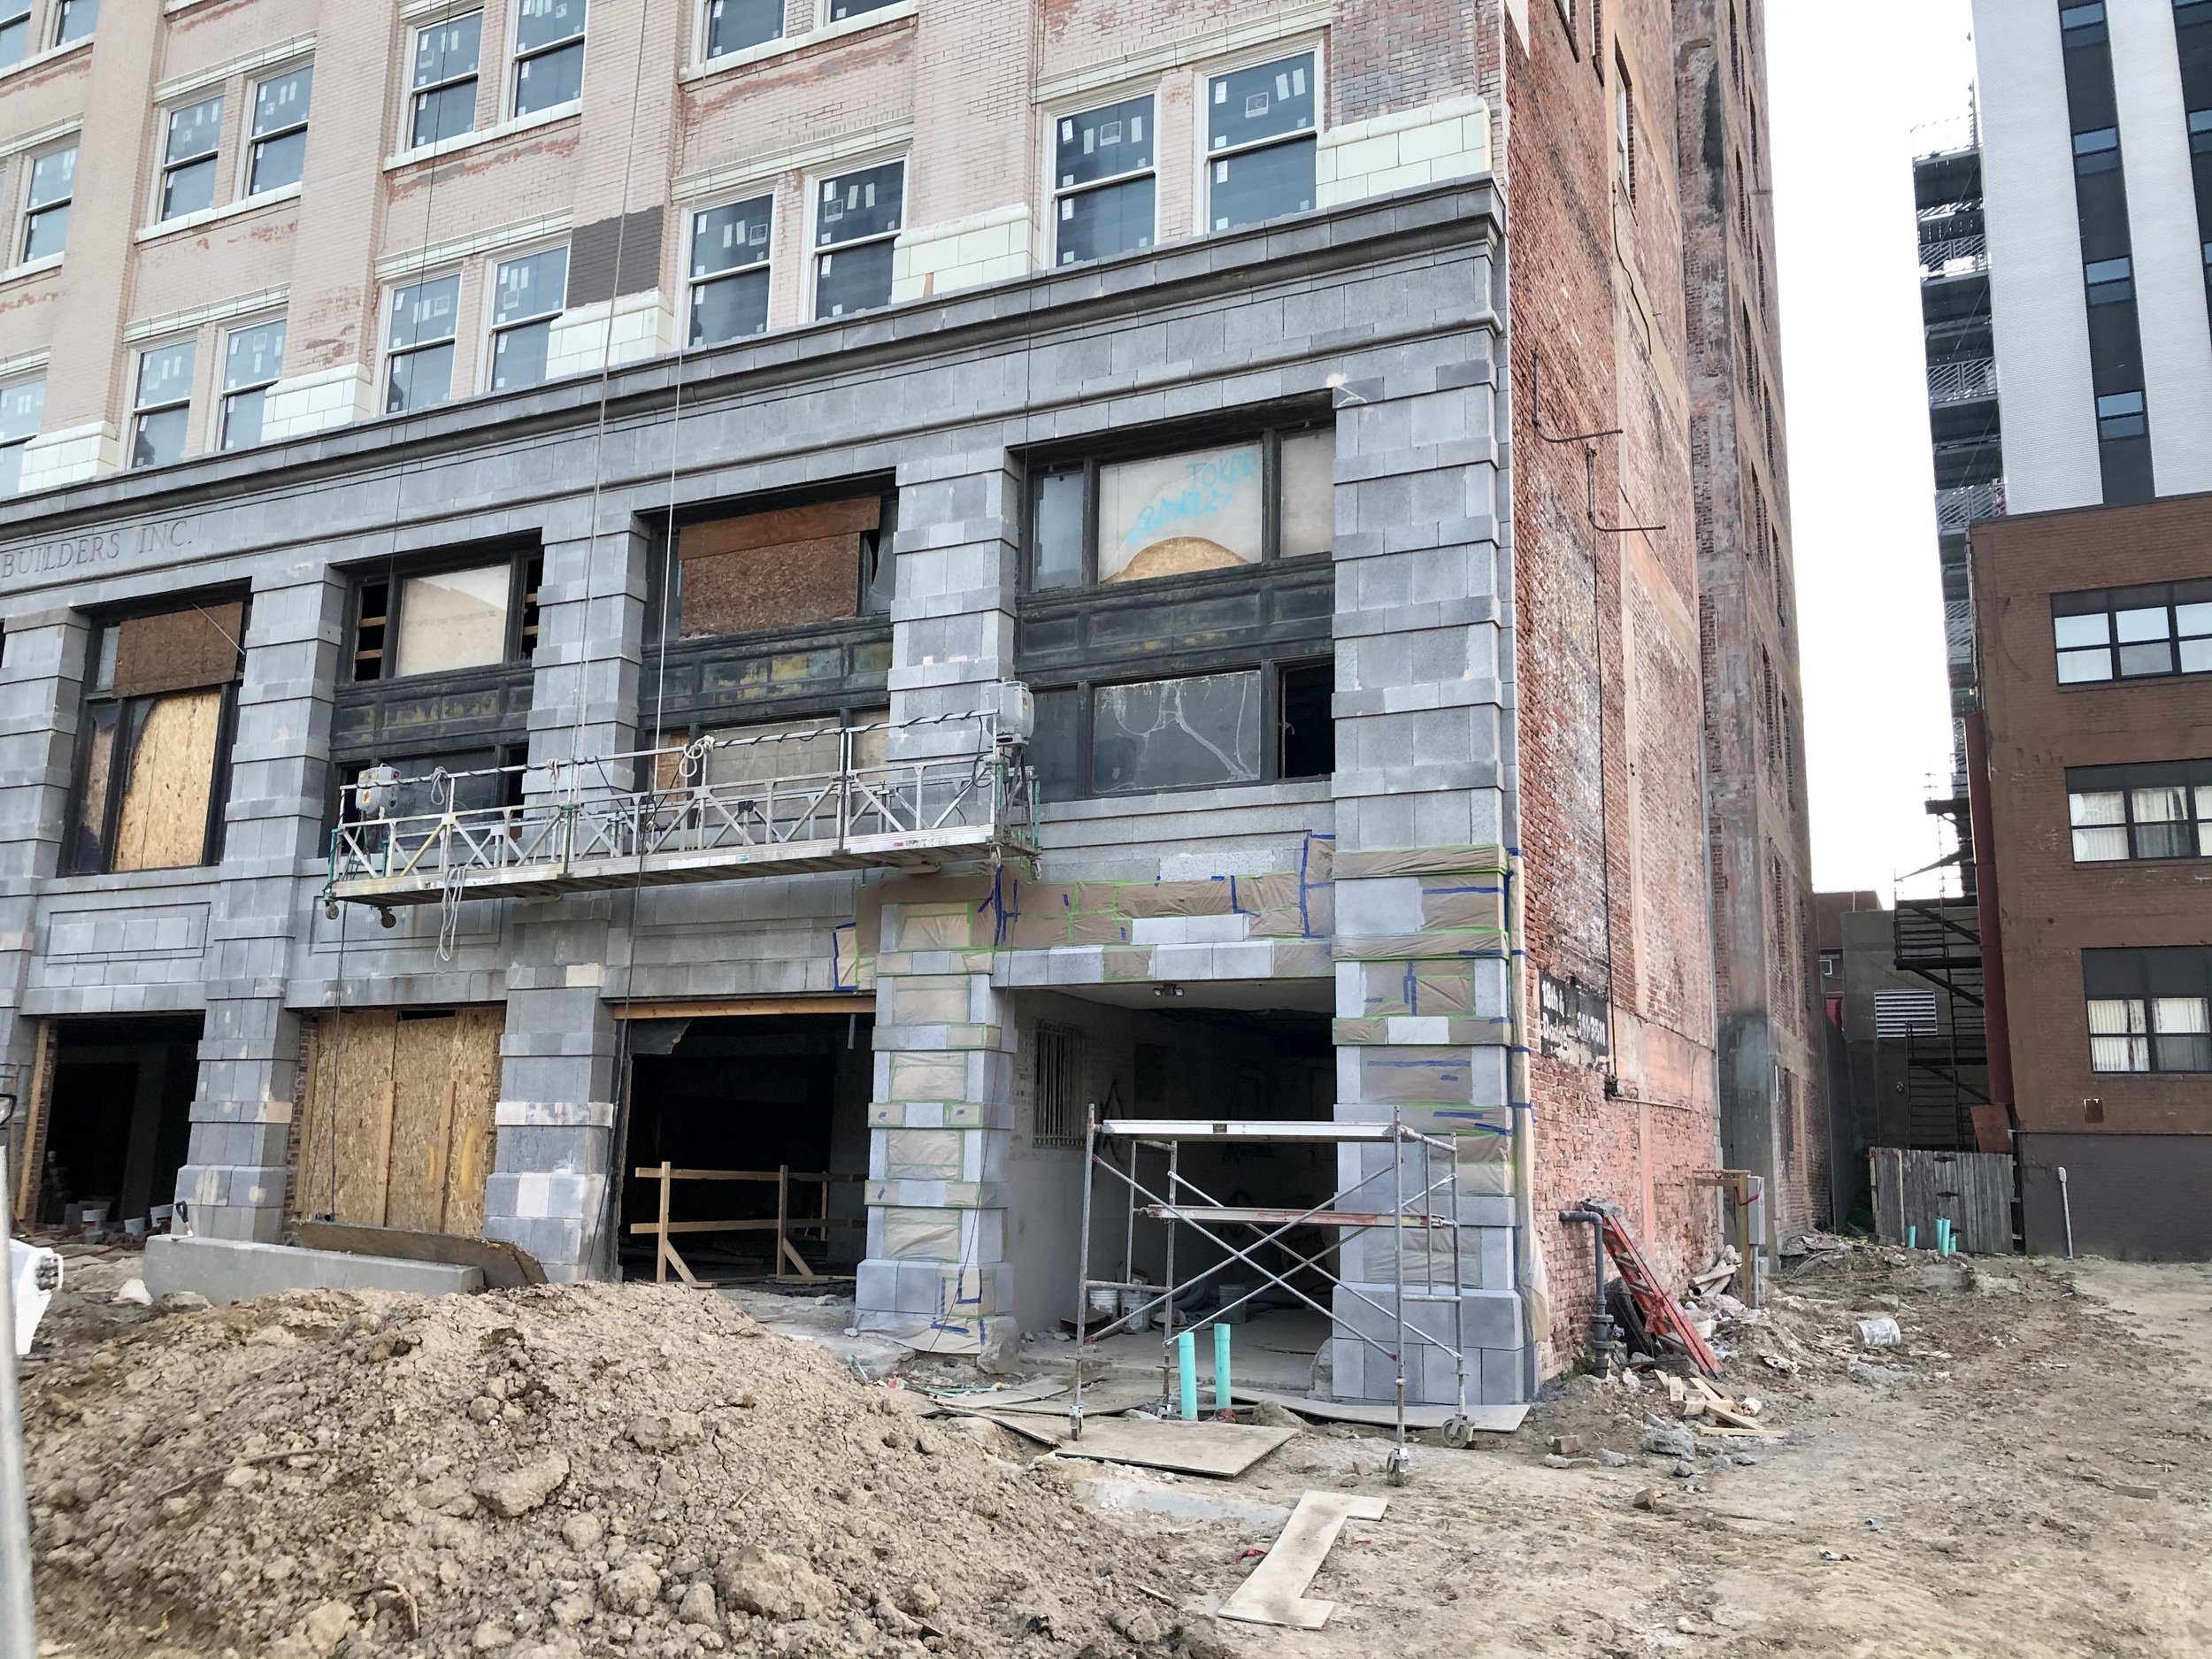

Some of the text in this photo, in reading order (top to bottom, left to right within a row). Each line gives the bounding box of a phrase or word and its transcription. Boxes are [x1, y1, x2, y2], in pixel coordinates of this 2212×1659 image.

[2, 520, 193, 578] BUILDERS INC.
[1541, 979, 1559, 1012] 18th
